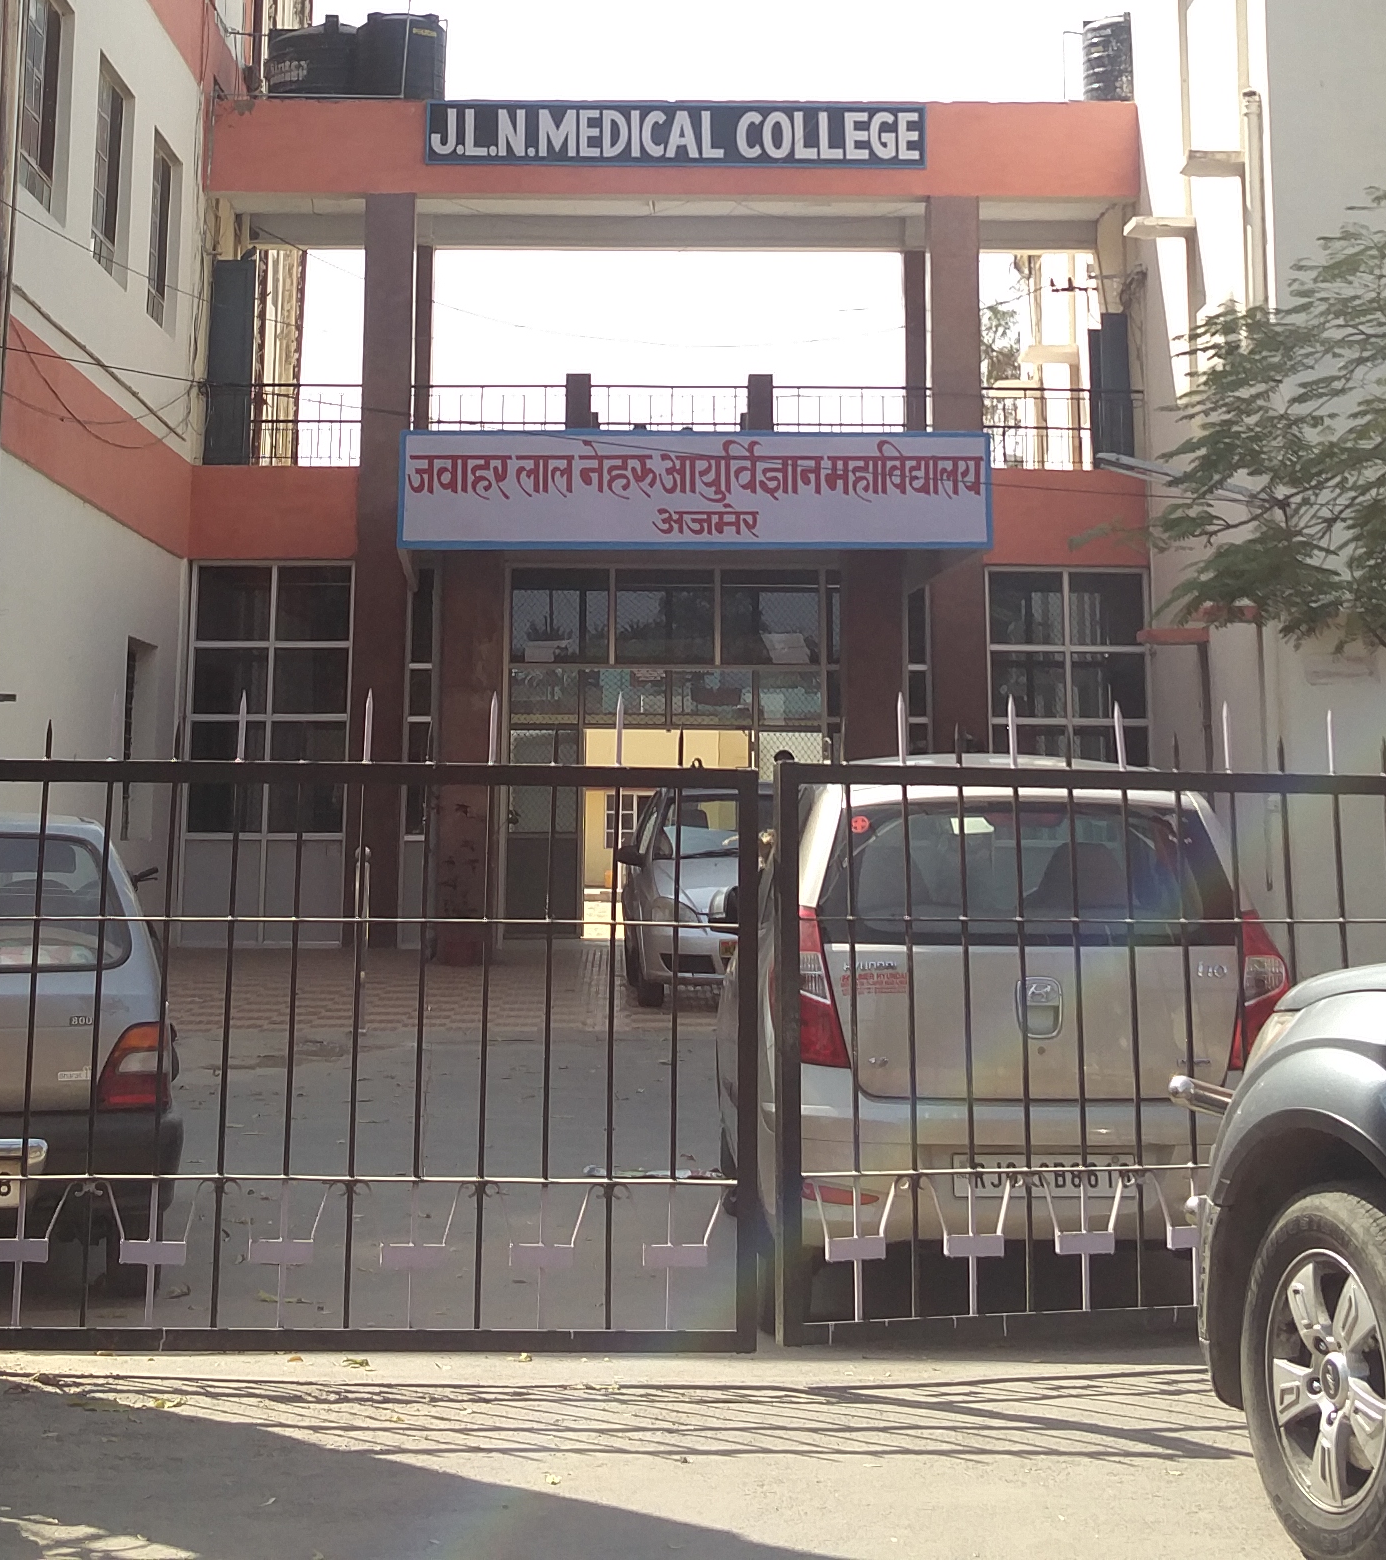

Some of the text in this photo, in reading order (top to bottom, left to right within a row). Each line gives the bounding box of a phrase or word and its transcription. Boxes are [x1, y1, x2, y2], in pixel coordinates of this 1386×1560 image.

[736, 111, 920, 160] COLLEGE
[407, 455, 511, 500] जवाहर
[515, 455, 573, 500] लाल
[825, 441, 983, 502] महाविद्यालय
[652, 502, 758, 537] अजमेर
[71, 1016, 92, 1025] 800
